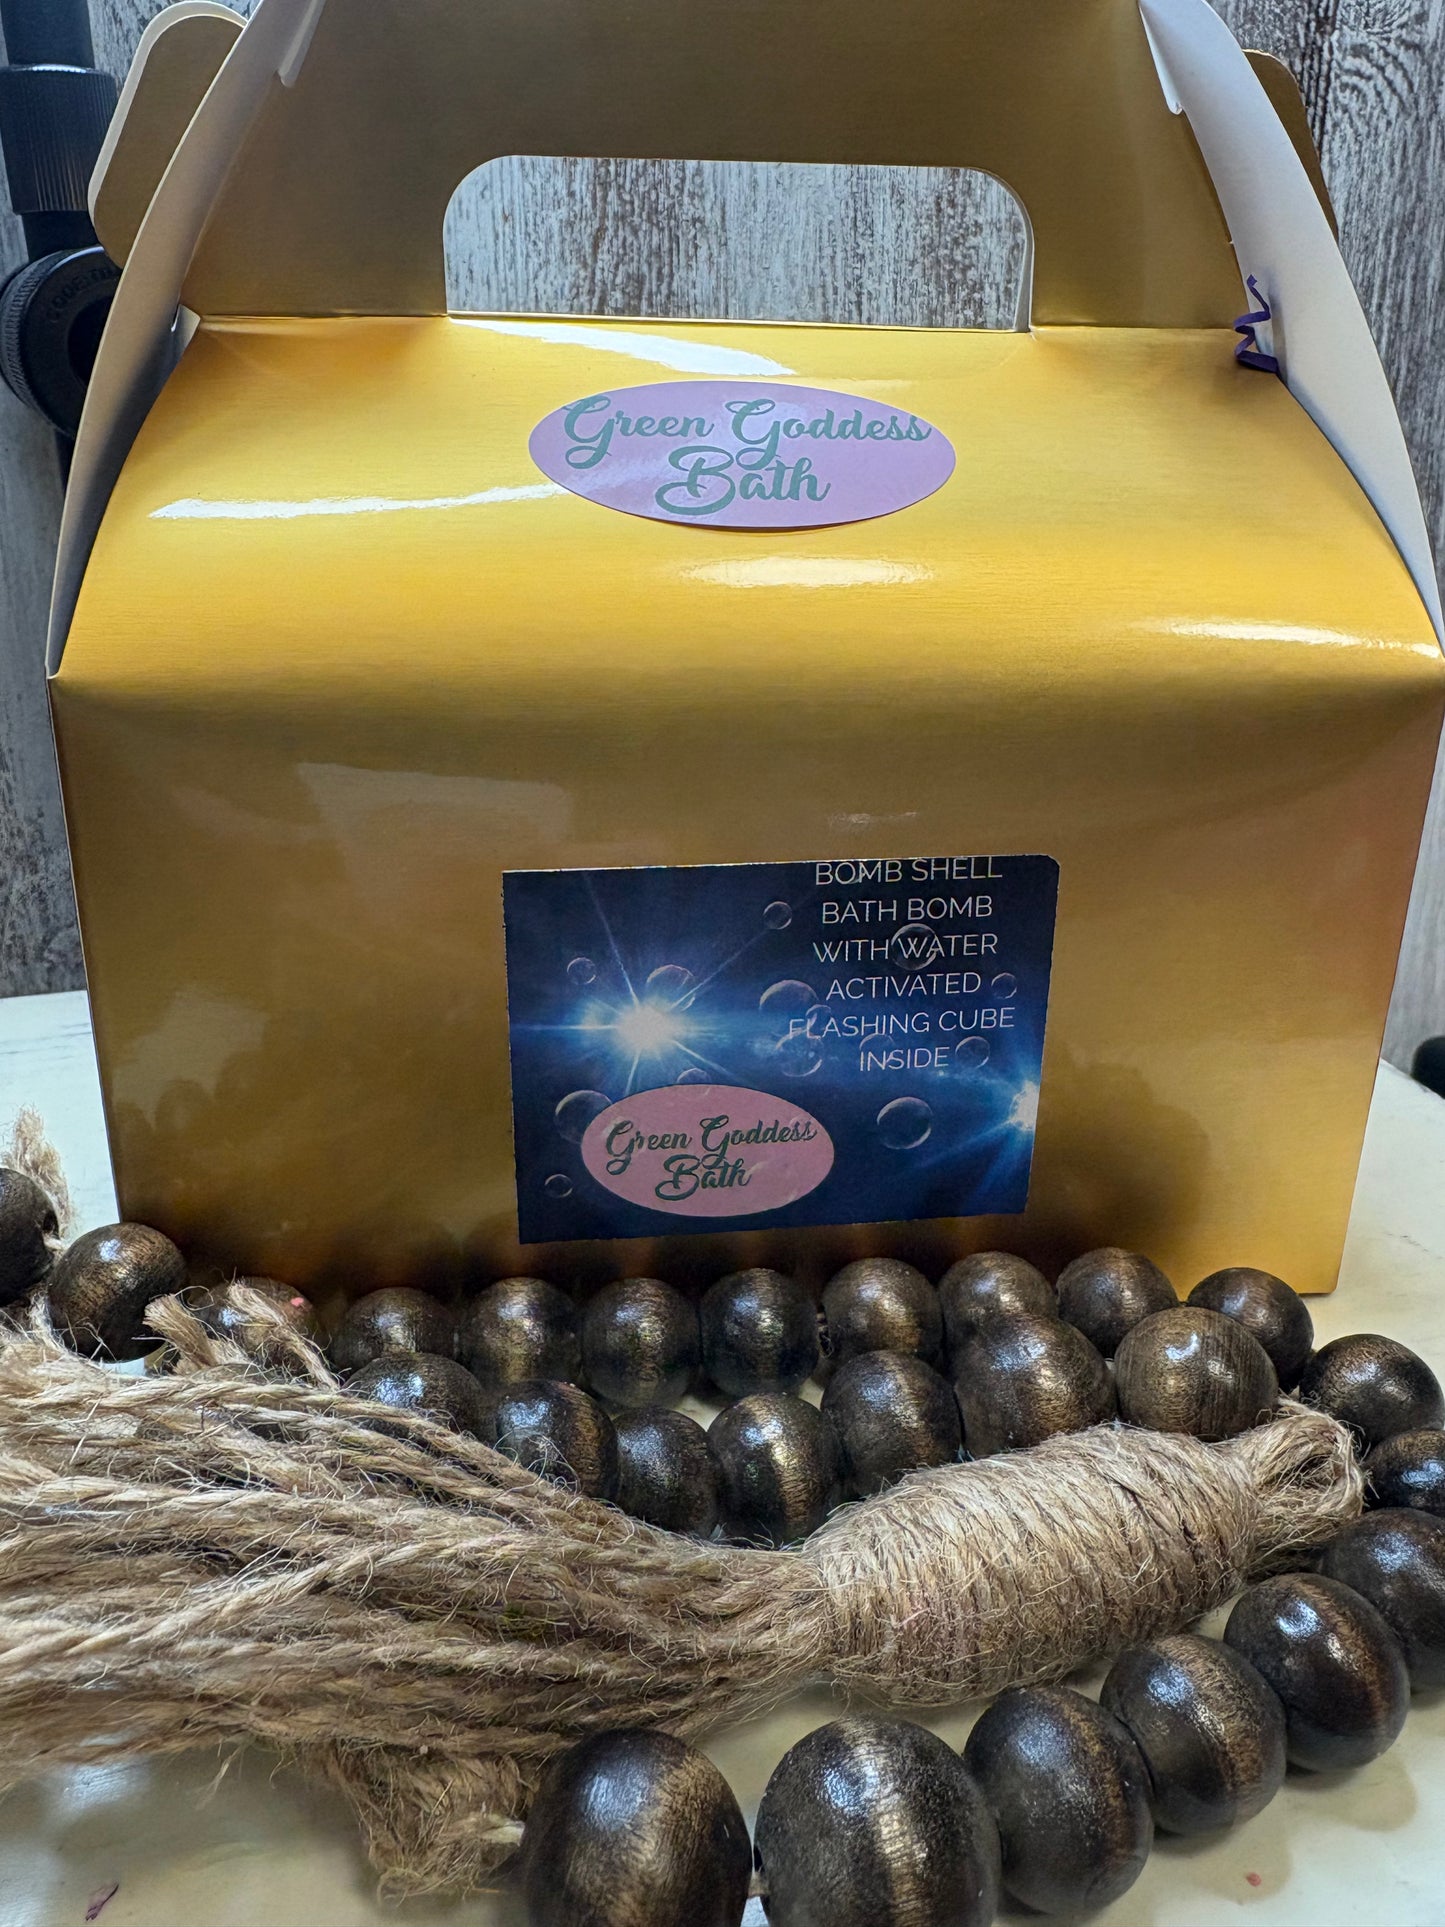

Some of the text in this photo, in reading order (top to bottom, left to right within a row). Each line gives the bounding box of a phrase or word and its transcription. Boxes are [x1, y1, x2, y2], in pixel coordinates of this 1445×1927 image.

[562, 395, 932, 471] Green Goddess
[654, 445, 831, 516] Bath
[815, 856, 1003, 886] BOMB SHELL
[822, 895, 993, 925] BATH BOMB
[812, 933, 999, 963] WITH WATER
[825, 972, 982, 1001] ACTIVATED
[788, 1007, 1016, 1040] FLASHING CUBE
[859, 1046, 950, 1072] INSIDE
[606, 1114, 818, 1176] Green Goddess
[654, 1153, 753, 1202] Bath
